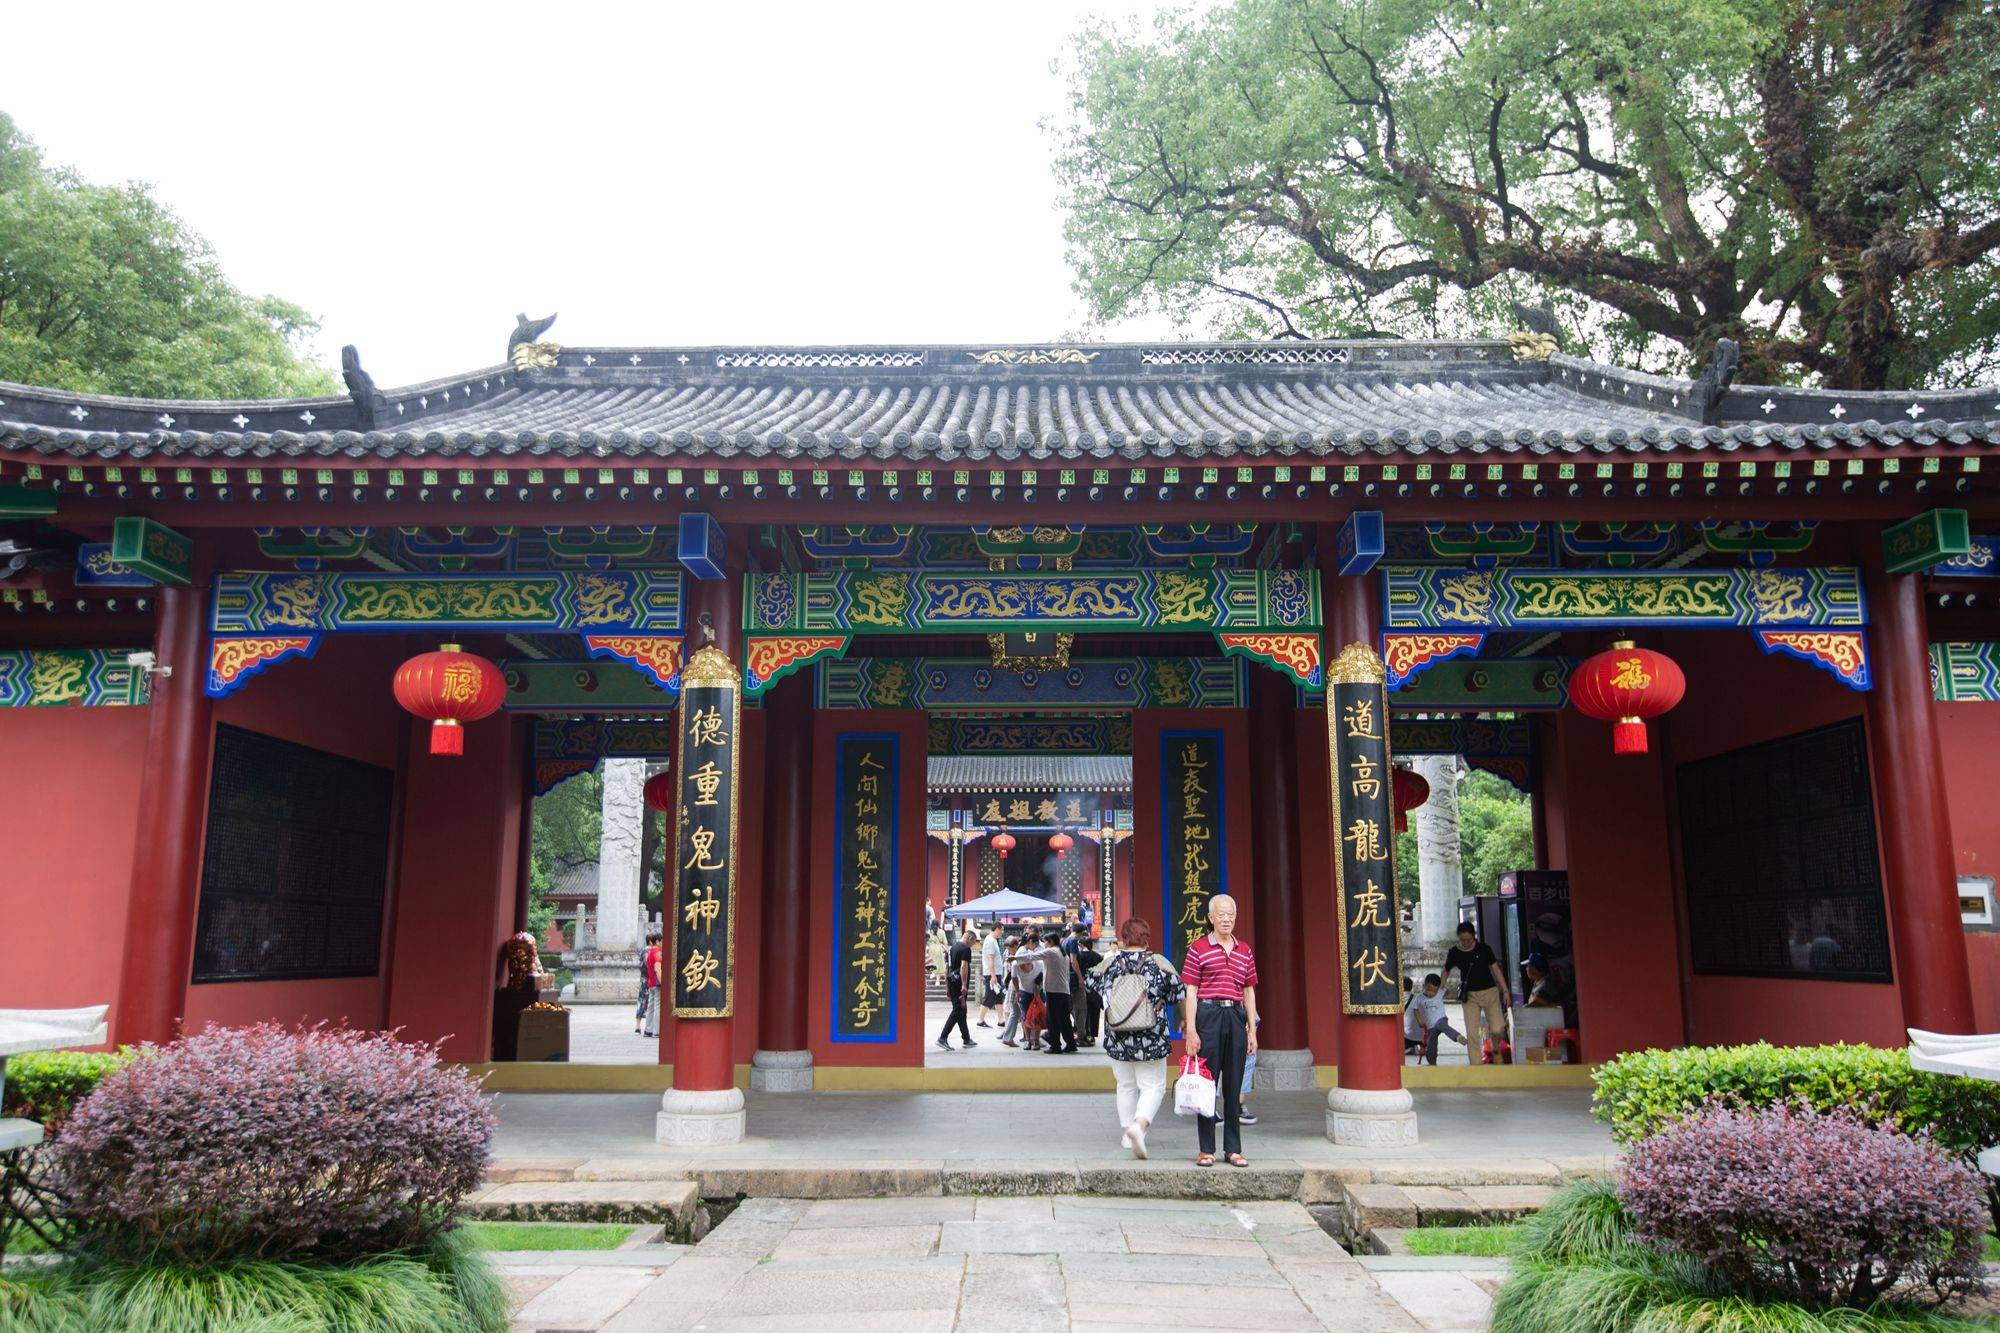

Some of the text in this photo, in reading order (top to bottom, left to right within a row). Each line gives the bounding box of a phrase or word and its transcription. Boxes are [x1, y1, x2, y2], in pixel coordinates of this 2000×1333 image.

[441, 668, 475, 703] 福
[1609, 658, 1652, 690] 福
[1343, 699, 1395, 991] 道高龍虎伏
